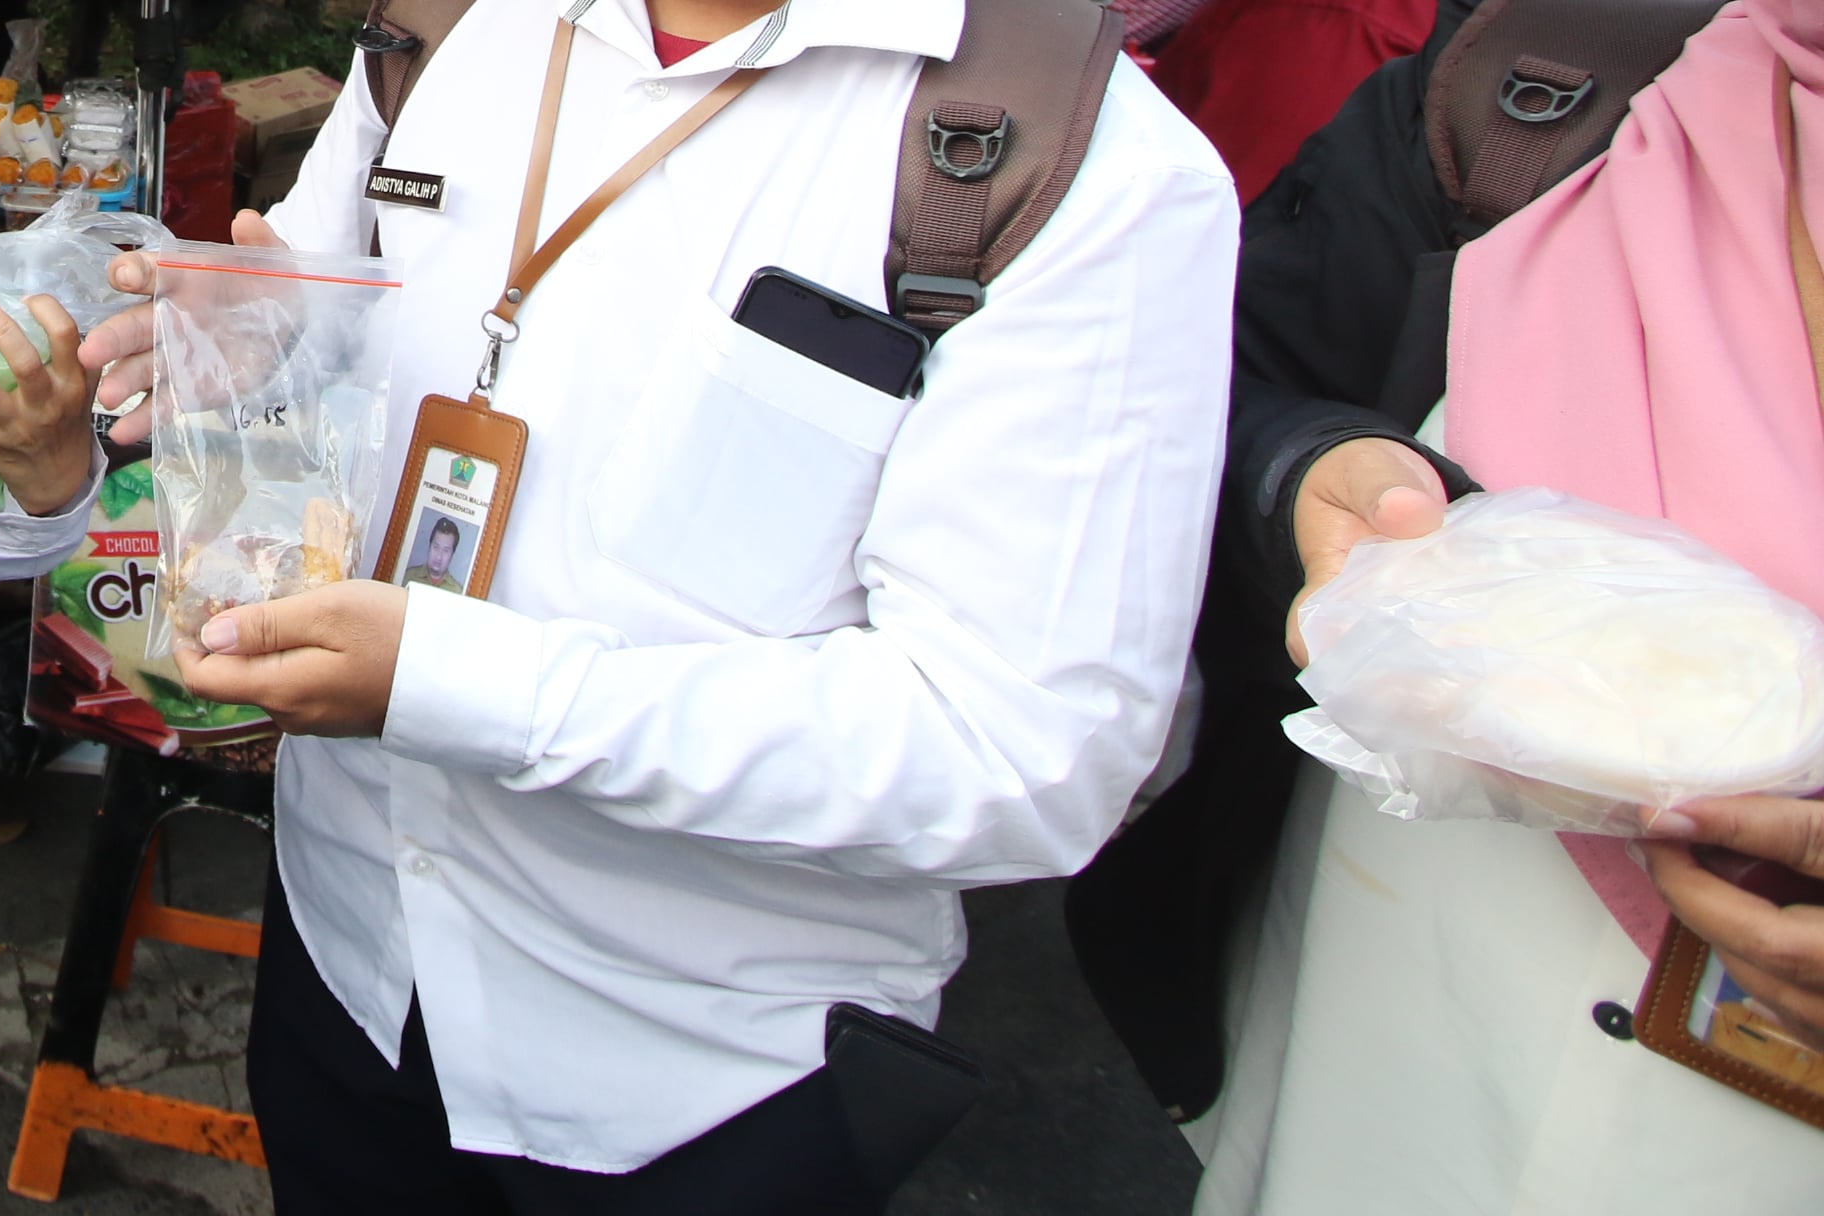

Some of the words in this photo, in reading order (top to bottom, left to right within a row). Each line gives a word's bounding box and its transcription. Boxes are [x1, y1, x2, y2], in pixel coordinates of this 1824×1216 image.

[369, 175, 403, 195] ADISTYA
[404, 180, 430, 200] GALIH
[430, 184, 439, 200] P
[454, 491, 469, 502] KOTA
[105, 537, 160, 553] CHOCOL
